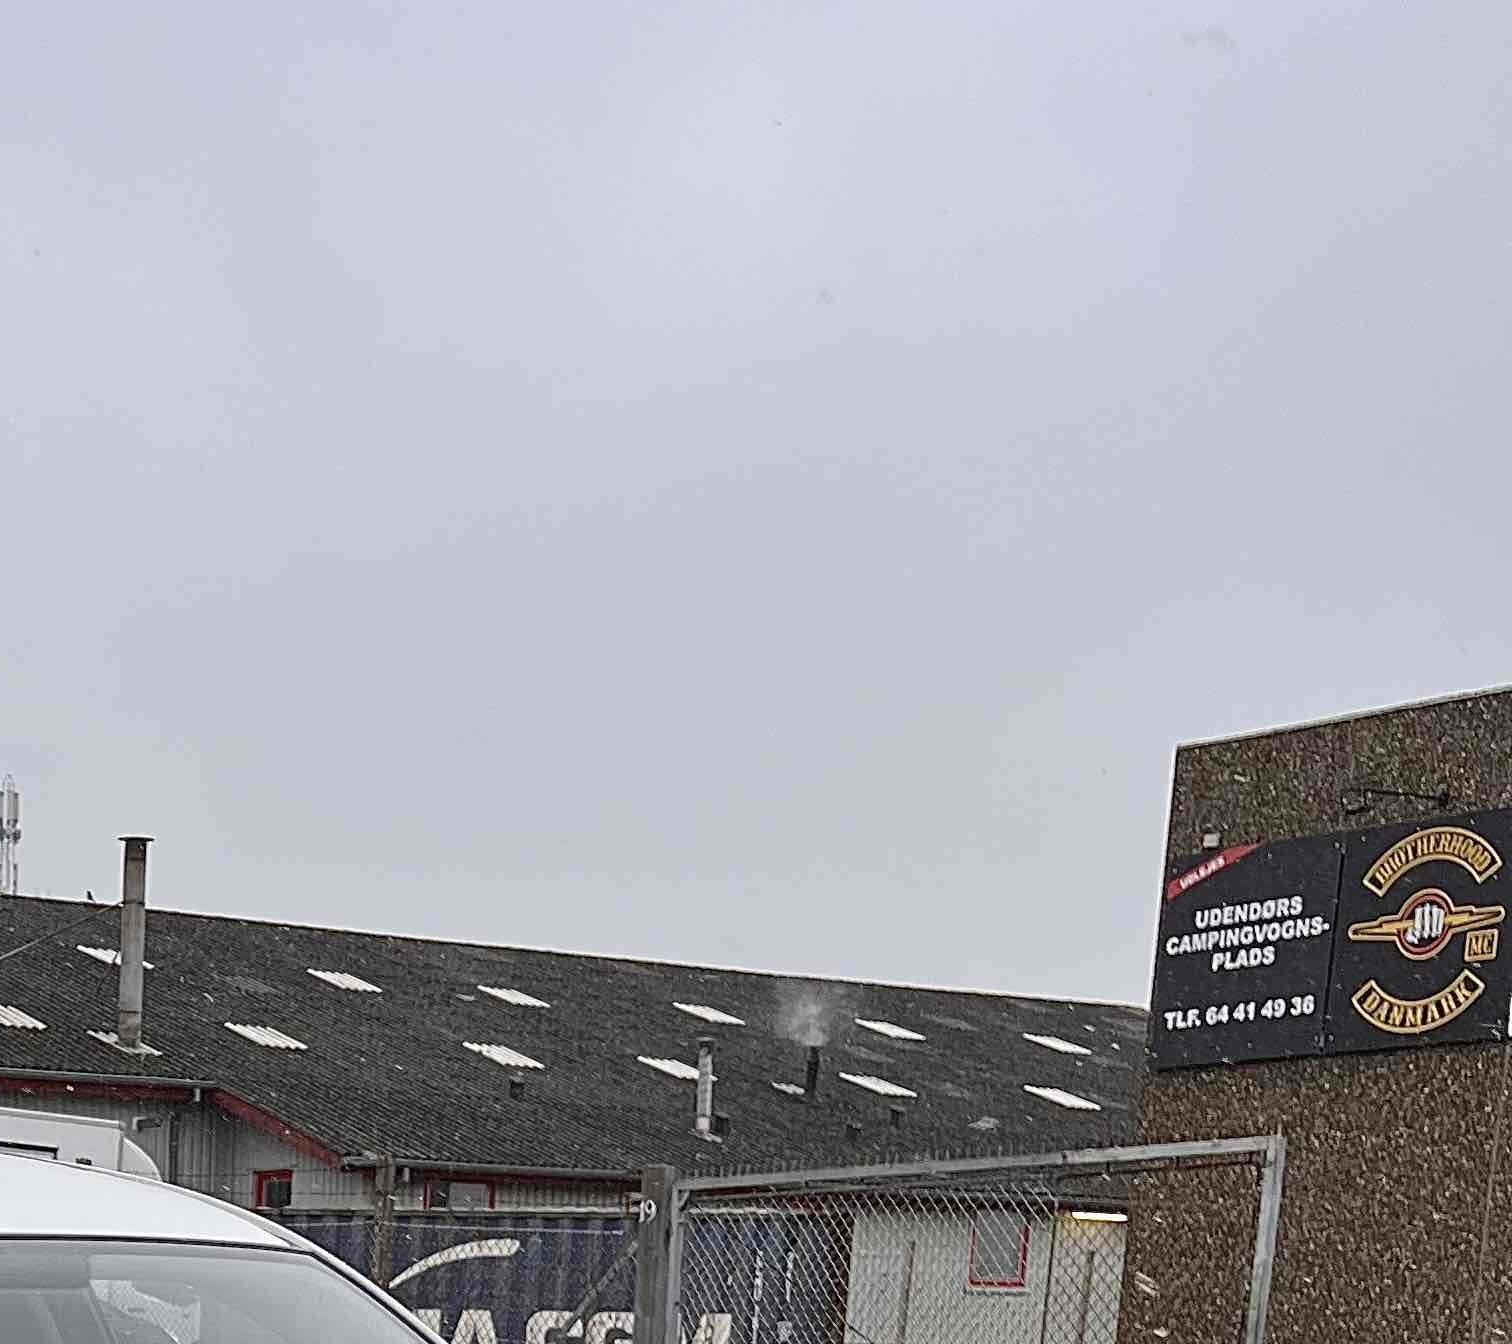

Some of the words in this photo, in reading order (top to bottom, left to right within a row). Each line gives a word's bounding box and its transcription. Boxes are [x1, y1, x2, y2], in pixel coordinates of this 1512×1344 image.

[1166, 916, 1330, 955] CAMPINGVOGNS-
[1470, 934, 1493, 957] MC
[1212, 946, 1275, 972] PLADS
[1206, 1005, 1229, 1026] 64
[1233, 1002, 1256, 1022] 41
[1261, 998, 1286, 1019] 49
[1362, 980, 1474, 1028] DANMARK
